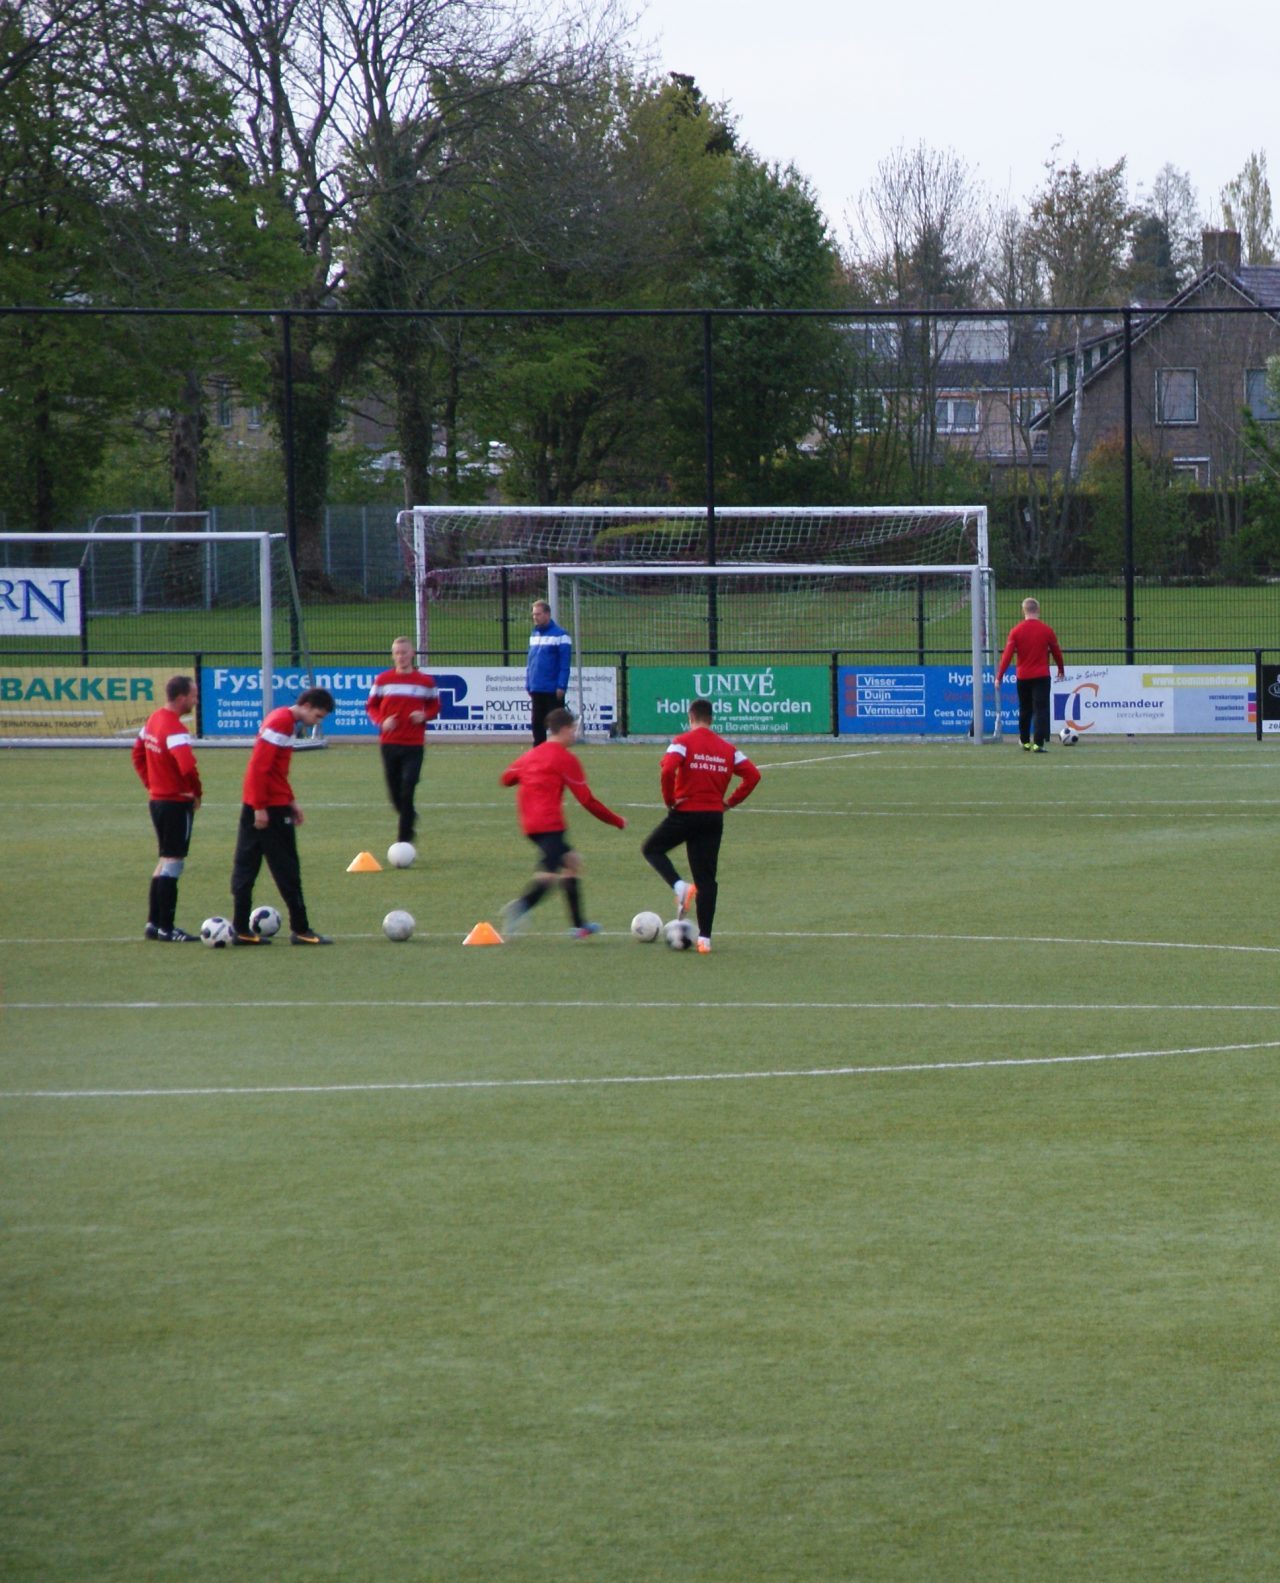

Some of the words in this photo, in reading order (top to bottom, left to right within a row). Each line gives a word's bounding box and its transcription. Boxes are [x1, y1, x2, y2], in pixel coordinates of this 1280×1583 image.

[693, 667, 776, 698] UNIVÉ
[864, 677, 896, 687] Visser
[0, 677, 155, 702] BAKKER
[864, 691, 891, 701] Duijn
[656, 699, 732, 714] Hollds
[738, 698, 811, 714] Noorden
[1084, 699, 1165, 710] commandeur
[864, 706, 918, 716] Vermeulen
[433, 723, 494, 731] VENHUIZEN
